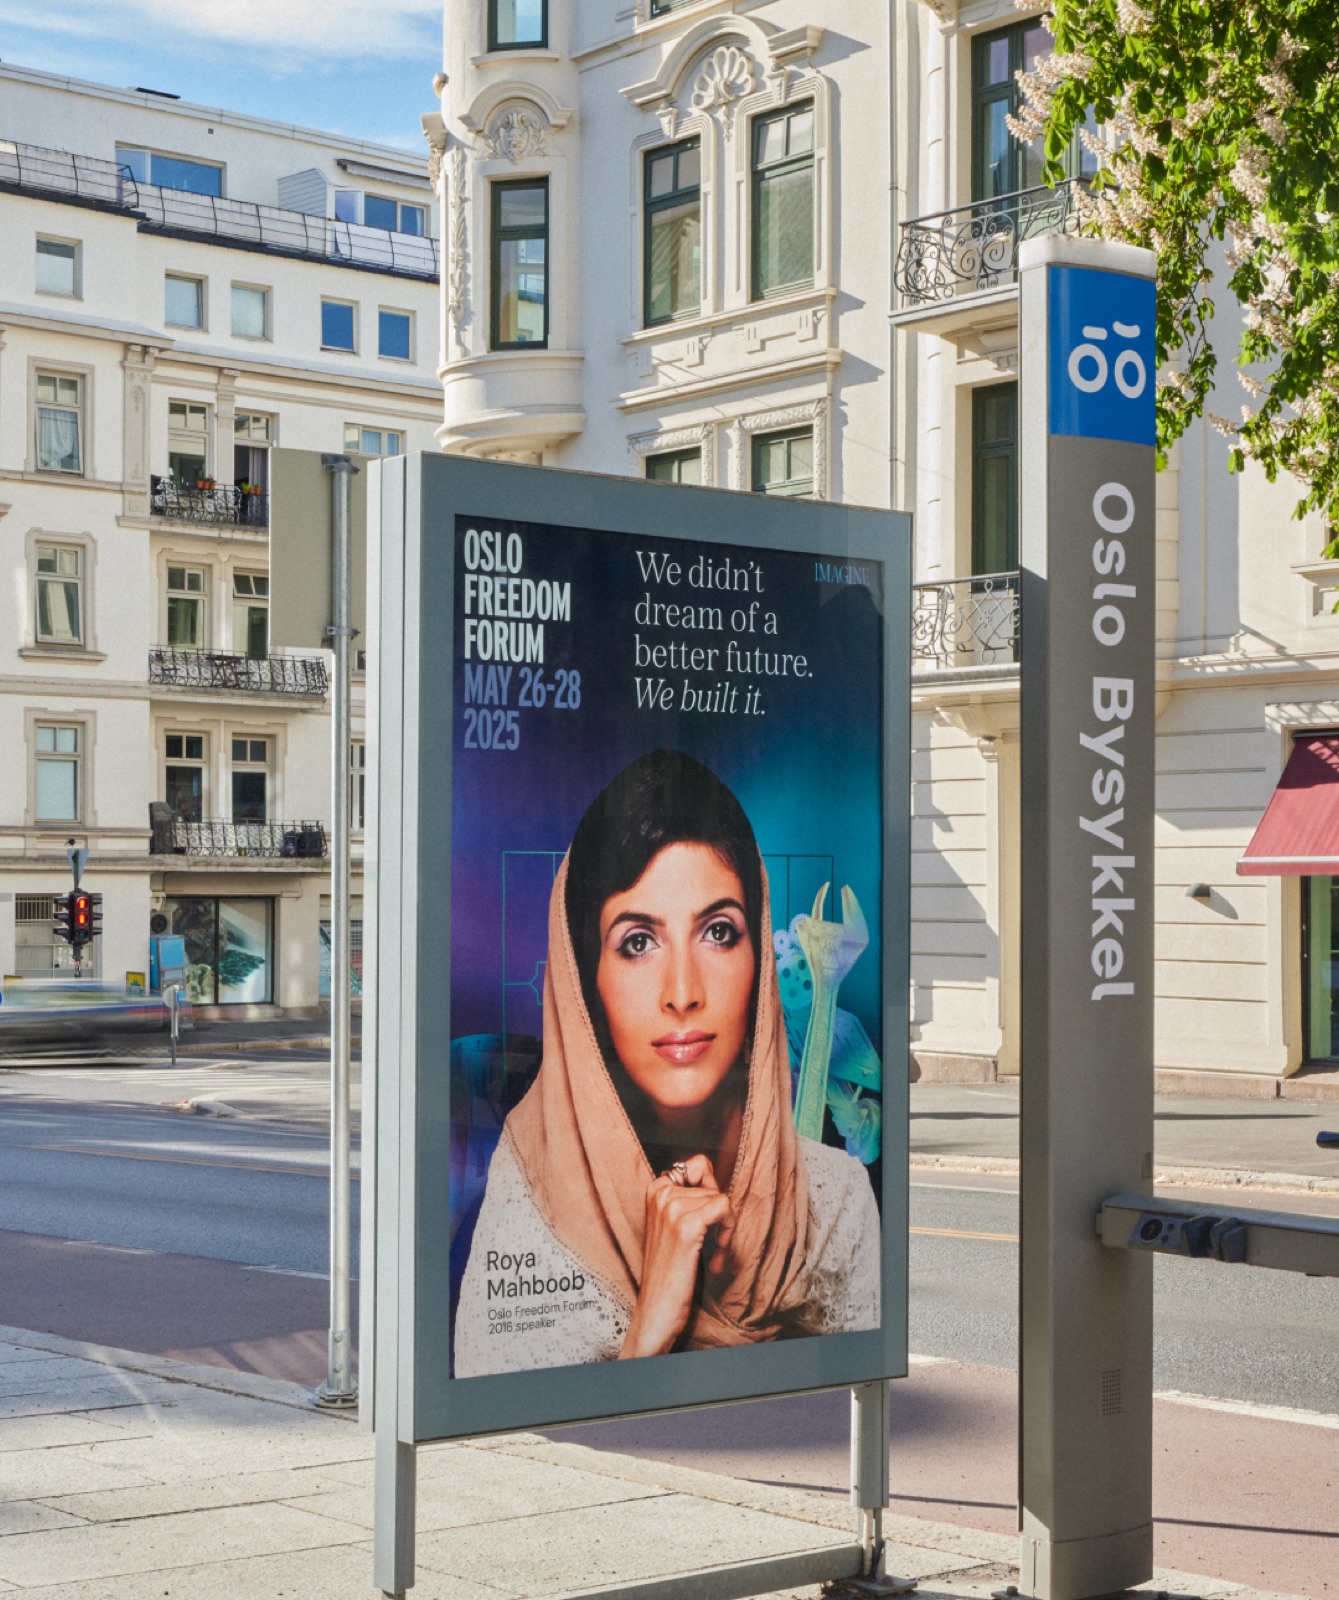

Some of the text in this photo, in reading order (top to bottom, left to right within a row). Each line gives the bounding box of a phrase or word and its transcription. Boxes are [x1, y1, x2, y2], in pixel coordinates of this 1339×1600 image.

[464, 529, 523, 574] OSLO
[635, 550, 765, 593] We didn’t
[814, 562, 870, 587] IMAGINE
[464, 573, 571, 622] FREEDOM
[634, 592, 778, 635] dream of a
[464, 618, 544, 664] FORUM
[634, 633, 813, 678] better future.
[464, 663, 581, 710] MAY 26-28
[634, 676, 766, 715] We built it.
[463, 707, 520, 751] 2025
[1079, 482, 1137, 1001] Oslo Bysykkel
[486, 1250, 536, 1276] Roya
[487, 1269, 585, 1301] Mahboob
[487, 1300, 595, 1321] Oslo Freedom Forum
[488, 1319, 557, 1335] 2016 speaker
